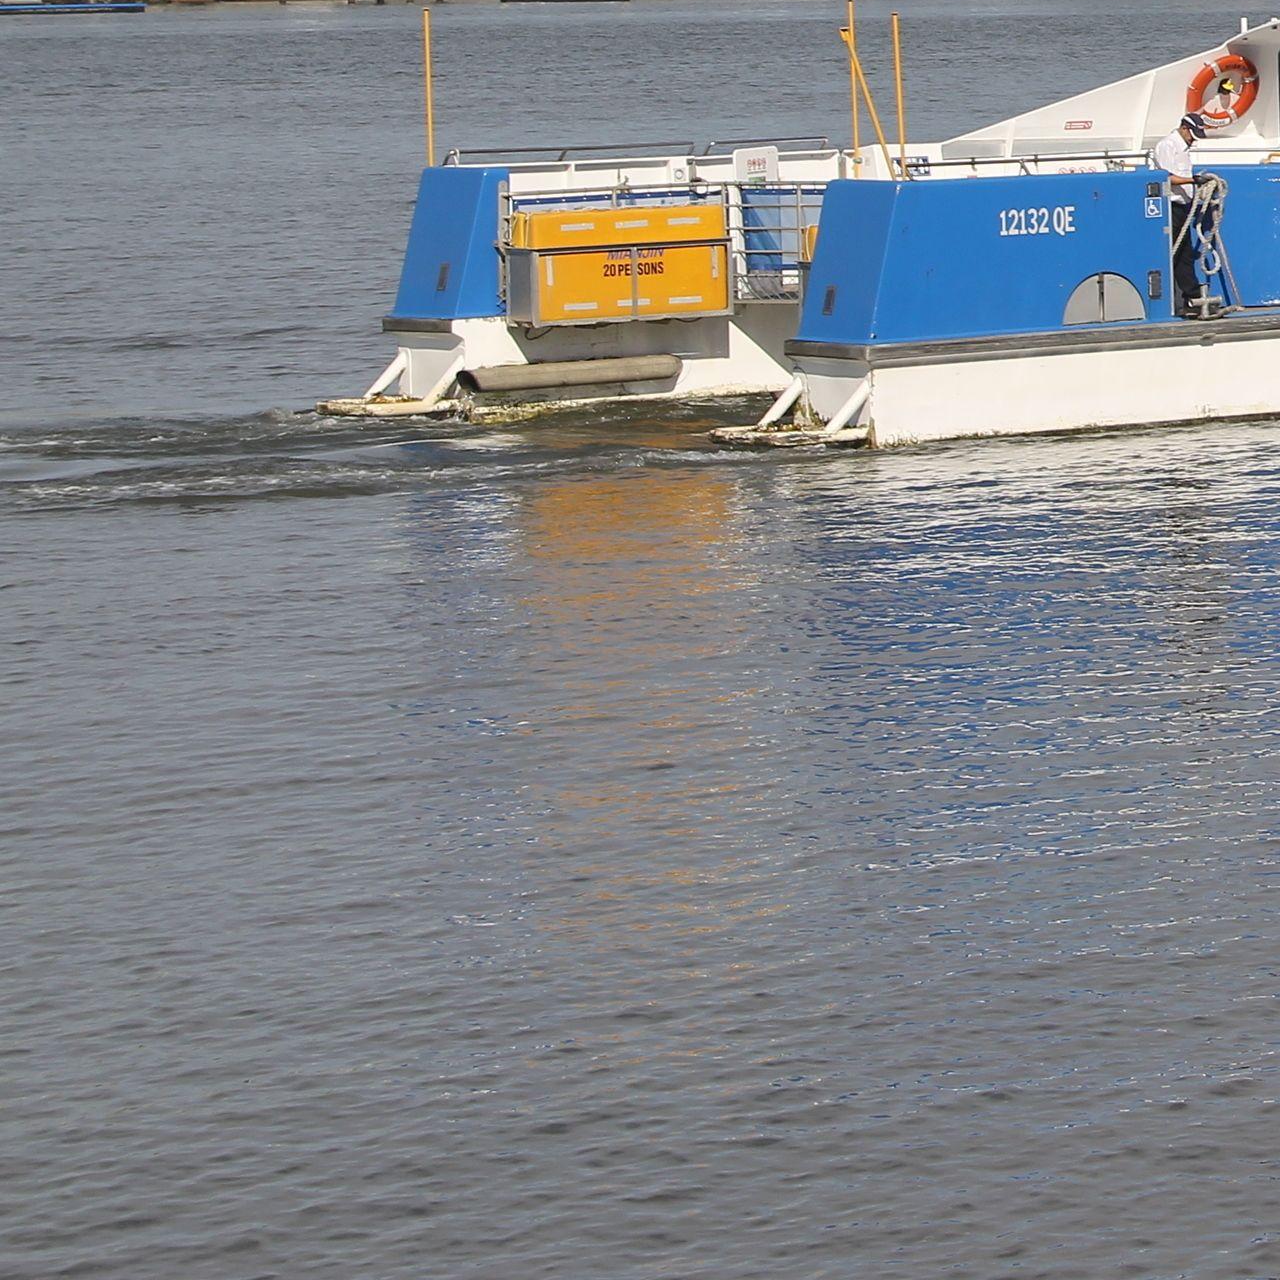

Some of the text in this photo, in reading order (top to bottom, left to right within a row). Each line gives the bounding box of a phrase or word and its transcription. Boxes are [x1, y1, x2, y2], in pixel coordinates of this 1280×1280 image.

[999, 206, 1076, 236] 12132 QE
[603, 261, 664, 277] 20 PESONS
